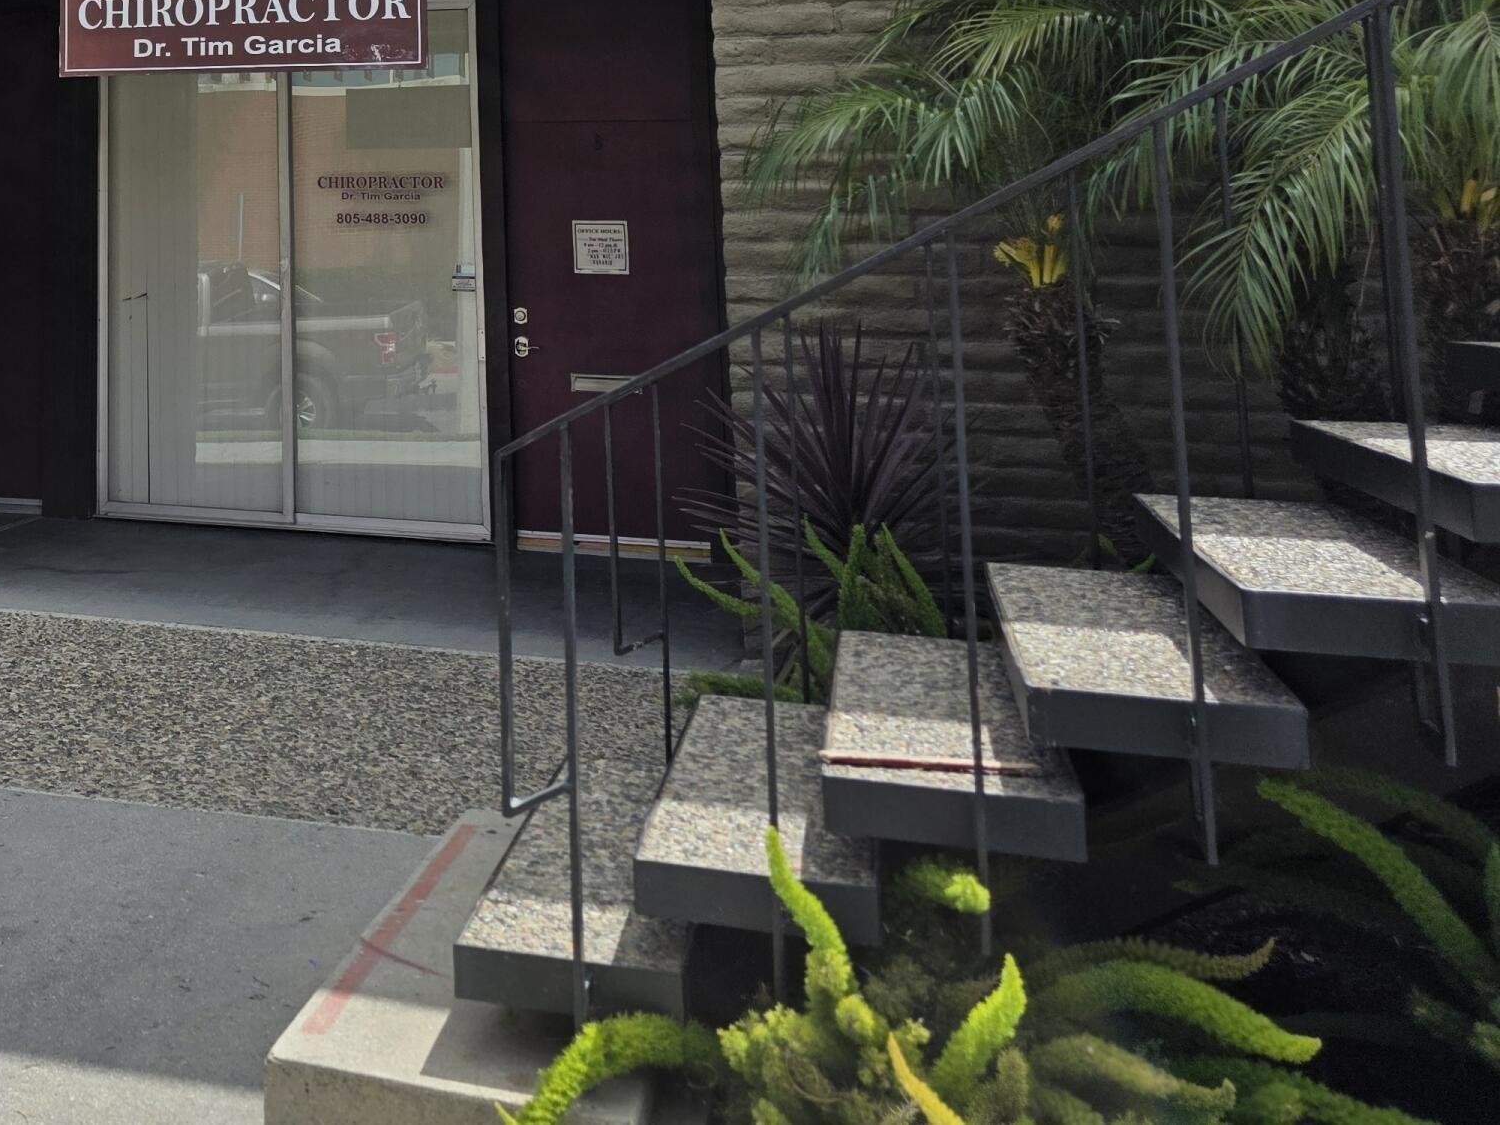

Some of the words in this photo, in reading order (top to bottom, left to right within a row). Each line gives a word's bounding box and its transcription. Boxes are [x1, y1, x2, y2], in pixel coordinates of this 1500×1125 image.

[133, 38, 171, 58] Dr.
[180, 36, 233, 56] Tim
[244, 33, 341, 55] Garcia
[317, 175, 445, 189] CHIROPRACTOR
[341, 192, 357, 201] Dr.
[360, 192, 381, 200] Tim
[384, 192, 421, 201] Garcia
[336, 213, 426, 225] 805-488-3090
